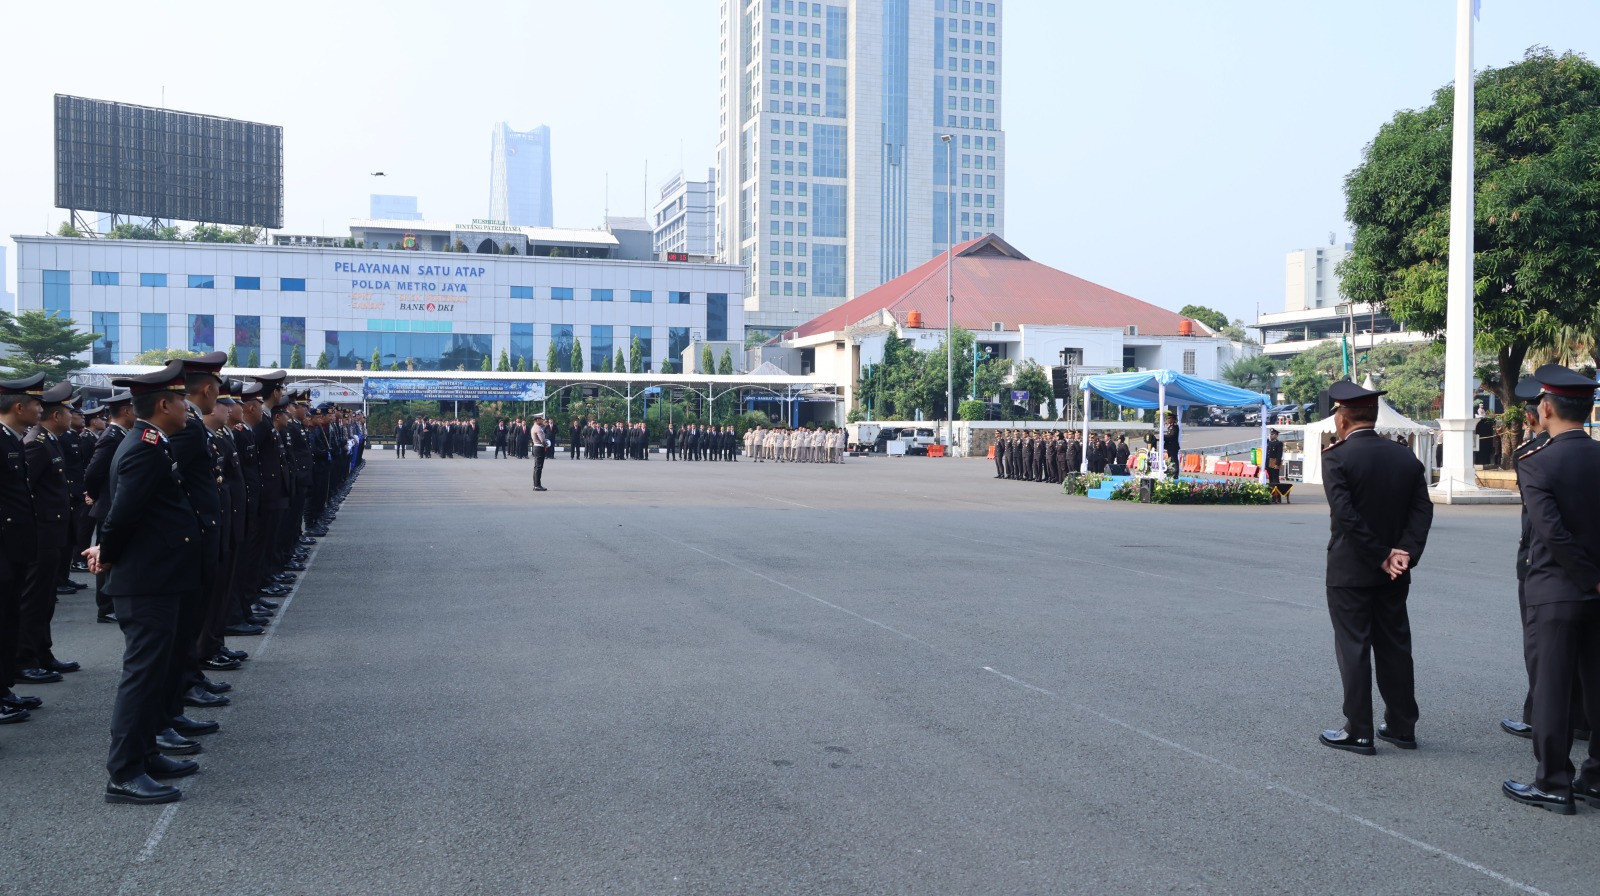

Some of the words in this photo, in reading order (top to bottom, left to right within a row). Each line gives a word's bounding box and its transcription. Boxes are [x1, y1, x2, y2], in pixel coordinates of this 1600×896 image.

[334, 261, 410, 275] PELAYANAN
[417, 265, 450, 276] SATU
[454, 266, 485, 277] ATAP
[351, 279, 391, 290] POLDA
[397, 281, 436, 292] METRO
[441, 282, 468, 293] JAYA
[399, 303, 425, 311] BANK
[437, 304, 454, 312] DKI
